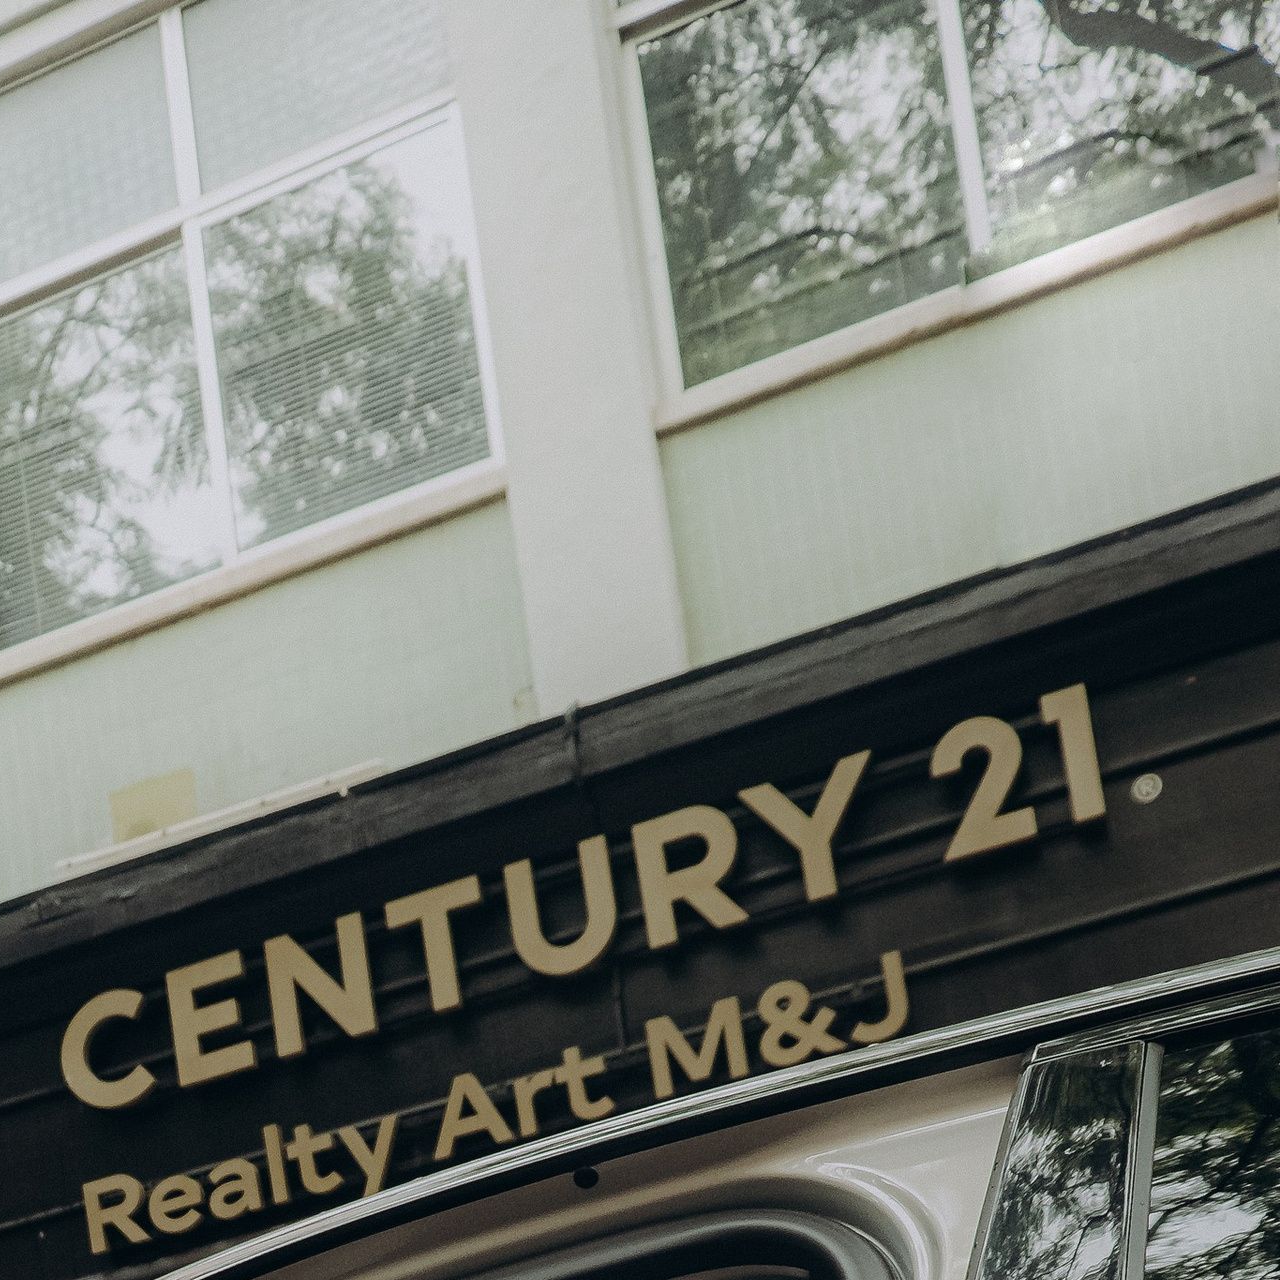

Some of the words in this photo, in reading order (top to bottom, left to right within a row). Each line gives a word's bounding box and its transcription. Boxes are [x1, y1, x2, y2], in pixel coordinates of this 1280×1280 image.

[60, 748, 873, 1110] CENTURY
[929, 682, 1107, 864] 21
[81, 1112, 399, 1256] Realty
[433, 1045, 616, 1162] Art
[644, 949, 911, 1101] M&J
